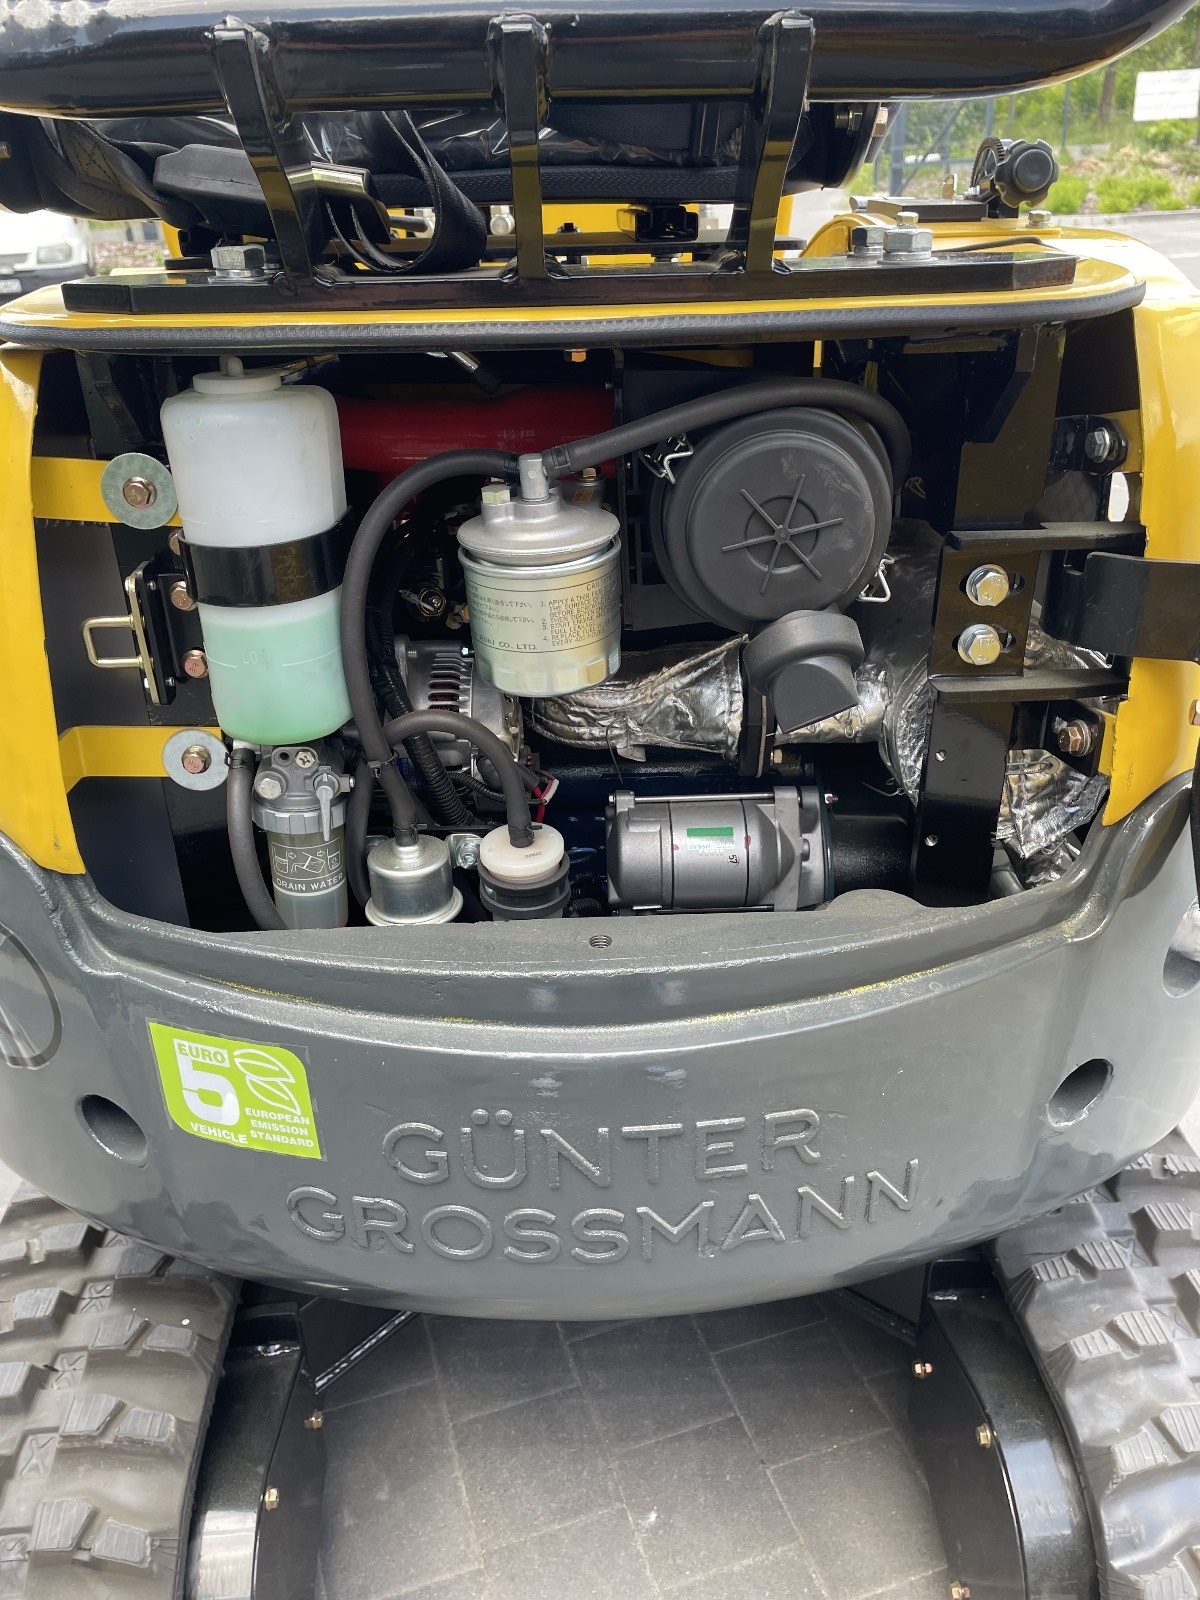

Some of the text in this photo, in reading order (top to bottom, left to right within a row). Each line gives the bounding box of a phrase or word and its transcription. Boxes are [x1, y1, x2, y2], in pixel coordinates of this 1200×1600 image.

[548, 597, 568, 607] APPLY
[576, 592, 590, 601] THIN
[549, 604, 563, 612] THE
[564, 599, 590, 610] SURFACE
[550, 608, 574, 617] BEFORE
[550, 615, 568, 624] THEN
[570, 609, 594, 620] TIGHTEN
[550, 621, 570, 630] START
[572, 614, 594, 626] ENGINE
[551, 627, 567, 635] FUEL
[551, 630, 580, 641] REPLACE
[552, 637, 573, 647] EVERY
[276, 873, 343, 891] DRAIN WATER
[176, 1042, 226, 1065] EURO
[176, 1056, 240, 1126] 5
[245, 1107, 310, 1125] EUROPEAN
[190, 1122, 248, 1144] VEHICLE
[250, 1119, 309, 1136] EMISSION
[249, 1130, 315, 1148] STANDARD
[382, 1108, 821, 1189] GÜNTER
[286, 1158, 919, 1263] GROSSMANN
